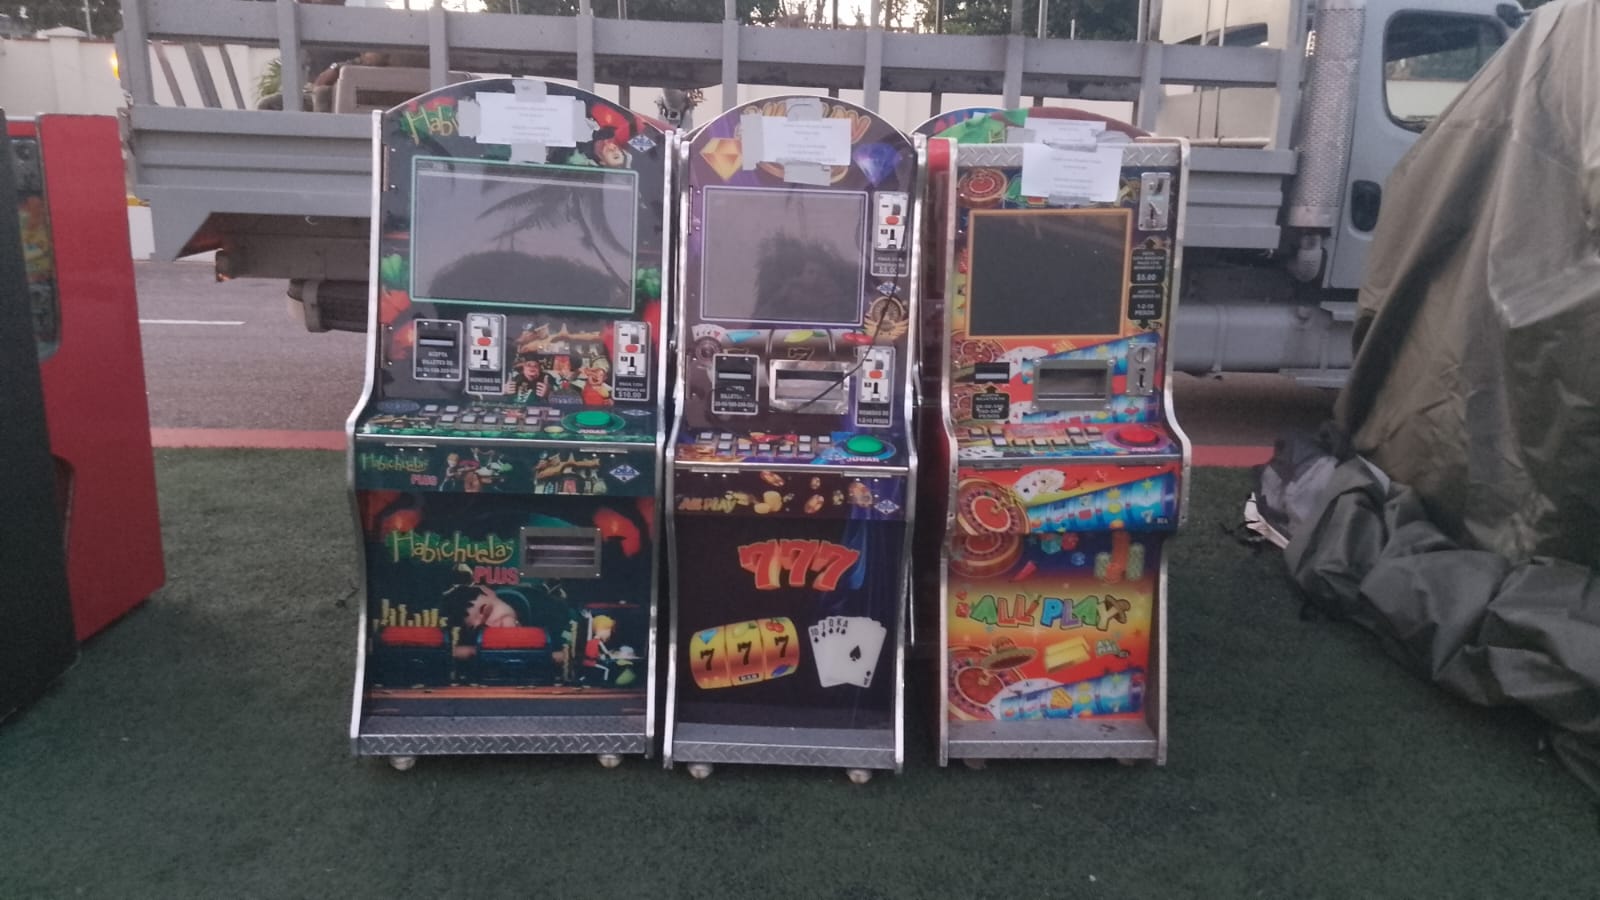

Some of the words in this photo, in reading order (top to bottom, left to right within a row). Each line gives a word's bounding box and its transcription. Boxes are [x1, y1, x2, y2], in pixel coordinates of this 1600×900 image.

[406, 105, 459, 145] Habi
[618, 391, 642, 399] $10.00
[410, 473, 438, 487] PLUS
[393, 529, 515, 565] Habichuelas
[736, 538, 861, 591] 777
[472, 565, 521, 585] PLUS
[969, 593, 1036, 629] ALL
[1039, 594, 1126, 632] PLAY
[700, 647, 716, 672] 7
[736, 640, 753, 666] 7
[774, 634, 790, 659] 7
